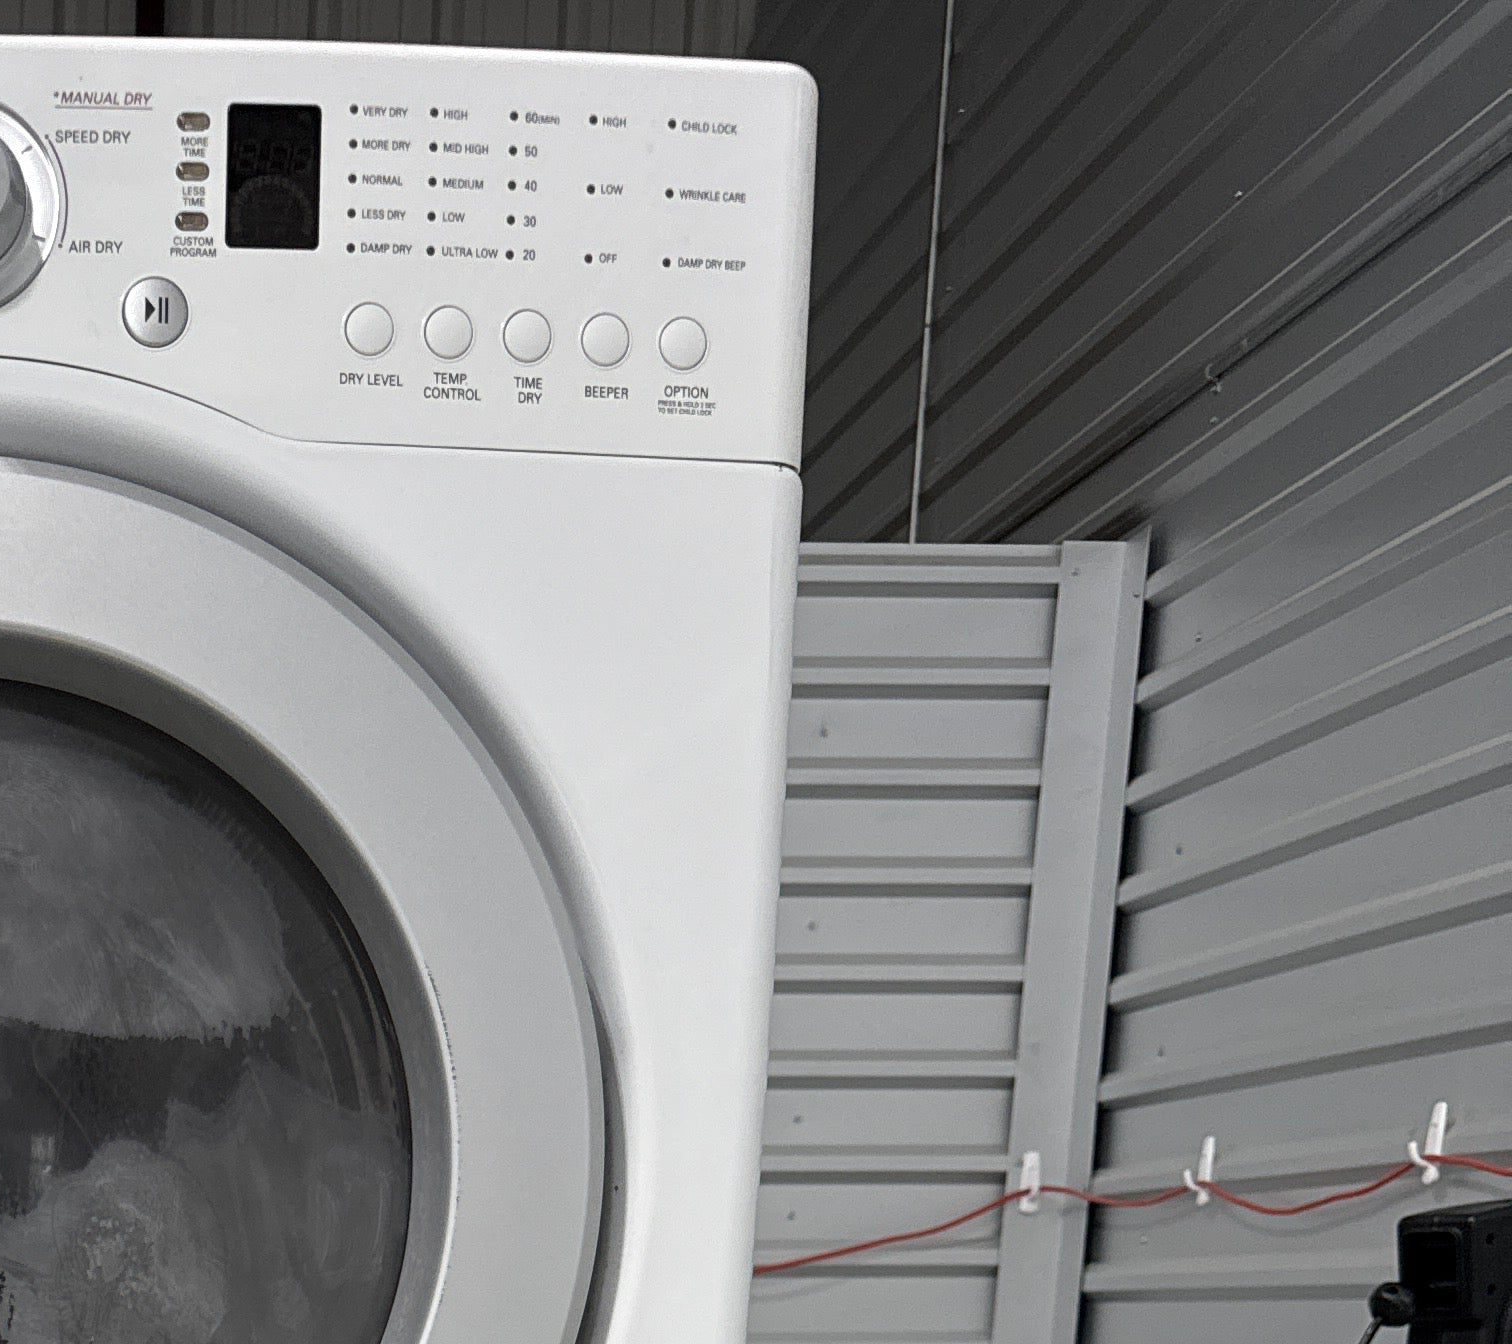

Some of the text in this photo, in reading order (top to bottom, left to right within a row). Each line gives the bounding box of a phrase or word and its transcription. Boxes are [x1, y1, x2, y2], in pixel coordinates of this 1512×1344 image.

[124, 92, 153, 106] DRY
[362, 106, 408, 118] VERY DRY
[443, 109, 468, 121] HIGH
[602, 117, 627, 128] HIGH
[681, 120, 737, 135] CHILD LOCK
[54, 130, 131, 144] SPEED DRY
[180, 136, 209, 147] MORE
[361, 140, 410, 152] MORE DRY
[464, 144, 489, 155] HIGH
[524, 146, 538, 157] 50
[183, 148, 206, 157] TIME
[362, 174, 403, 186] NORMAL
[442, 178, 484, 190] MEDIUM
[523, 180, 538, 192] 40
[600, 184, 623, 195] LOW
[182, 198, 206, 207] TIME
[722, 192, 746, 203] CARE
[361, 209, 406, 221] LESS DRY
[442, 212, 465, 223] LOW
[523, 215, 537, 227] 30
[68, 240, 124, 254] AIR DRY
[172, 236, 214, 247] CUSTOM
[169, 248, 217, 257] PROGRAM
[360, 242, 412, 255] DAMP DRY
[441, 246, 498, 259] ULTRA LOW
[522, 249, 536, 261] 20
[598, 253, 618, 264] OFF
[677, 257, 703, 269] DAMP
[705, 258, 722, 270] DRY
[339, 372, 403, 387] DRY LEVEL
[513, 376, 543, 391] TIME
[422, 386, 482, 401] CONTROL
[517, 391, 542, 405] DRY
[584, 385, 629, 400] BEEPER
[664, 385, 709, 399] OPTION
